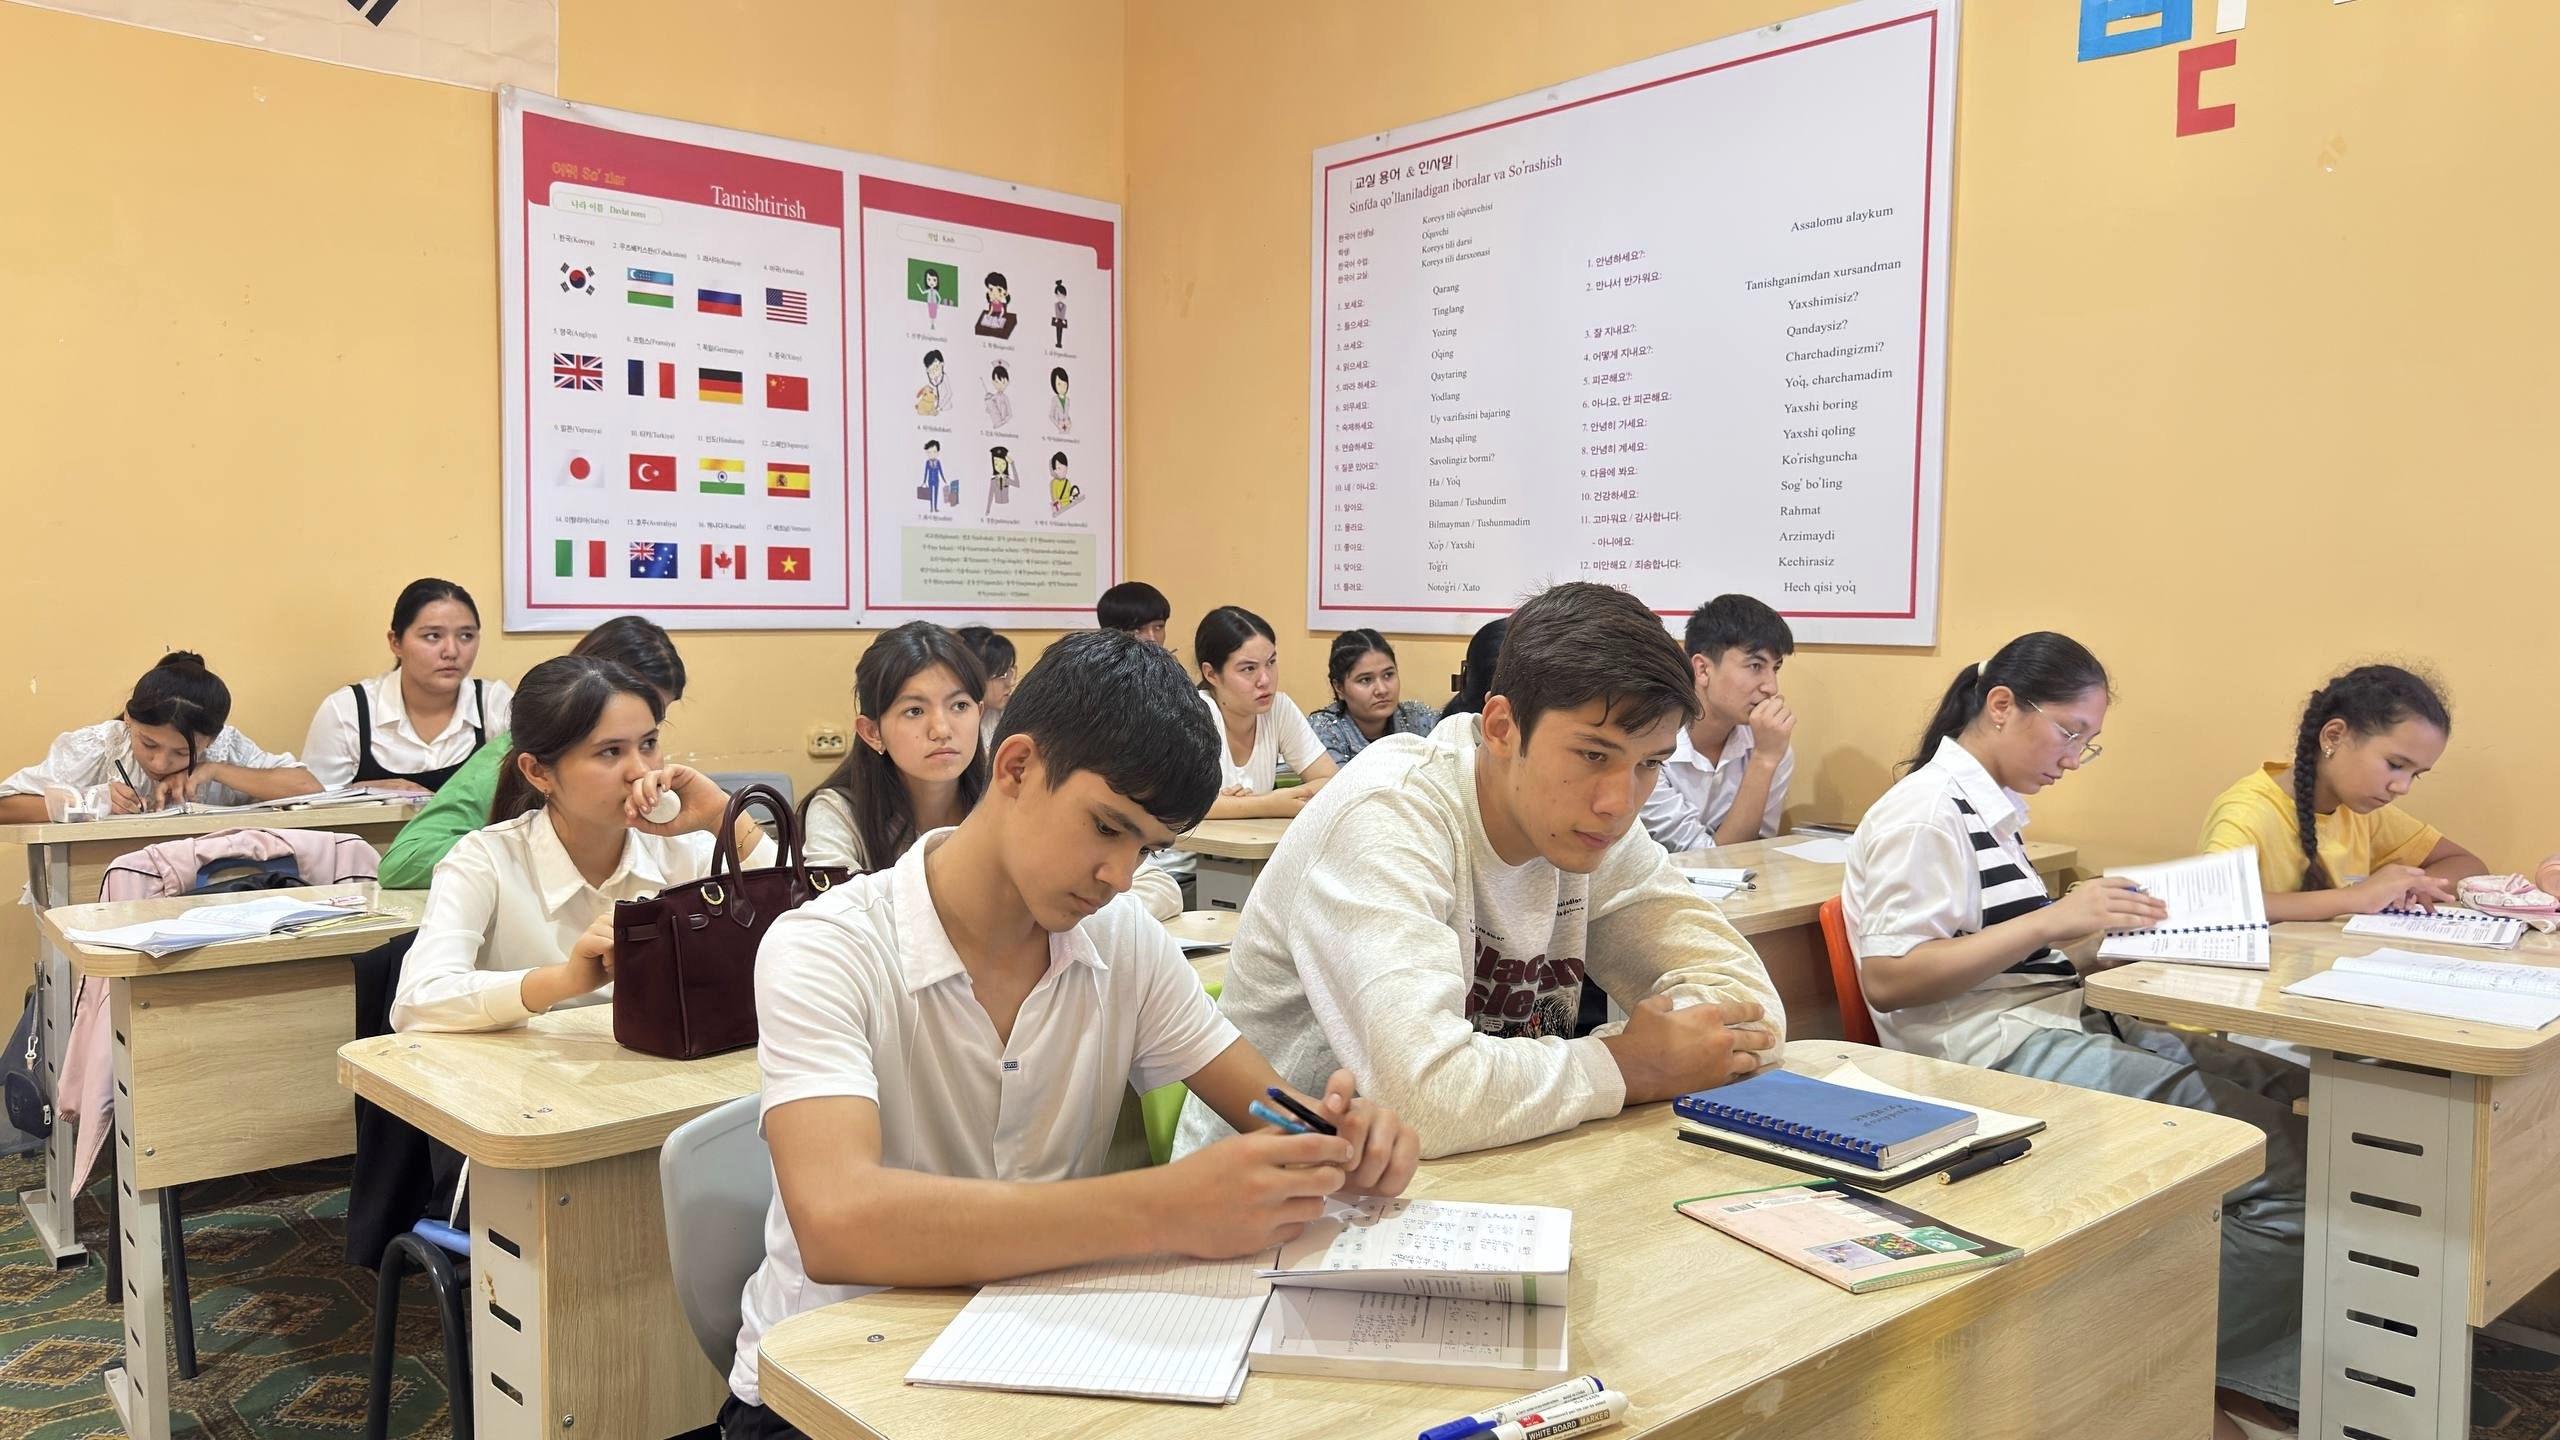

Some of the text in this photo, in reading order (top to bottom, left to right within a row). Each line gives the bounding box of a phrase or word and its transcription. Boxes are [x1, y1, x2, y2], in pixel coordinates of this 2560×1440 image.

[1355, 173, 1376, 190] 교실
[1379, 168, 1400, 185] 용어
[1418, 155, 1453, 175] 인사말
[1349, 197, 1378, 215] Sinfda
[1452, 172, 1491, 191] iboralar
[1494, 171, 1505, 181] va
[711, 184, 807, 220] Tanishtirish
[1422, 213, 1445, 225] Koreys
[1446, 210, 1456, 219] tili
[1791, 207, 1893, 232] Assalomu alaykum
[1422, 237, 1473, 254] Koreys tili darsi
[1421, 257, 1444, 268] Koreys
[1445, 254, 1454, 263] tili
[1587, 259, 1594, 268] 1.
[1745, 260, 1901, 291] Tanishganimdan xursandman
[1432, 283, 1460, 296] Qarang
[1586, 283, 1593, 292] 2.
[1596, 277, 1621, 291] 만나서
[1788, 291, 1859, 311] Yaxshimisiz?
[1432, 304, 1464, 316] Tinglang
[1432, 327, 1457, 338] Yozing
[1585, 330, 1591, 339] 3.
[1786, 319, 1848, 338] Qandaysiz?
[1584, 354, 1591, 362] 4.
[1593, 349, 1618, 362] 어떻게
[1786, 342, 1885, 362] Charchadingizmi?
[1431, 369, 1467, 382] Qaytaring
[1583, 376, 1590, 385] 5.
[1812, 368, 1893, 385] charchamadim
[1431, 391, 1460, 402] Yodlang
[1582, 400, 1590, 408] 6.
[1784, 398, 1858, 414] Yaxshi boring
[1430, 407, 1511, 425] Uy vazifasini bajaring
[1582, 423, 1588, 432] 7.
[1590, 420, 1616, 432] 안녕히
[1783, 425, 1856, 439] Yaxshi qoling
[1429, 432, 1477, 445] Mashq qiling
[1590, 444, 1616, 456] 안녕히
[1429, 453, 1495, 466] Savolingiz bormi?
[1581, 470, 1588, 478] 9.
[1590, 467, 1616, 479] 다음에
[1429, 478, 1440, 487] Ha
[1429, 497, 1507, 508] Bilaman Tushundim
[1581, 493, 1592, 501] 10.
[1780, 506, 1821, 516] Rahmat
[1428, 517, 1531, 530] Bilmayman Tushunmadim
[1581, 516, 1591, 524] 11.
[1593, 513, 1627, 524] 고마워요
[1779, 530, 1835, 543] Arzimaydi
[1450, 541, 1475, 550] Yaxshi
[1580, 561, 1591, 570] 12.
[1593, 560, 1627, 570] 미안해요
[1778, 556, 1835, 567] Kechirasiz
[1462, 583, 1480, 592] Xato
[1784, 581, 1810, 592] Hech
[1814, 581, 1832, 594] qisi
[1553, 1421, 1577, 1435] BOARD
[1580, 1411, 1610, 1426] MARKER
